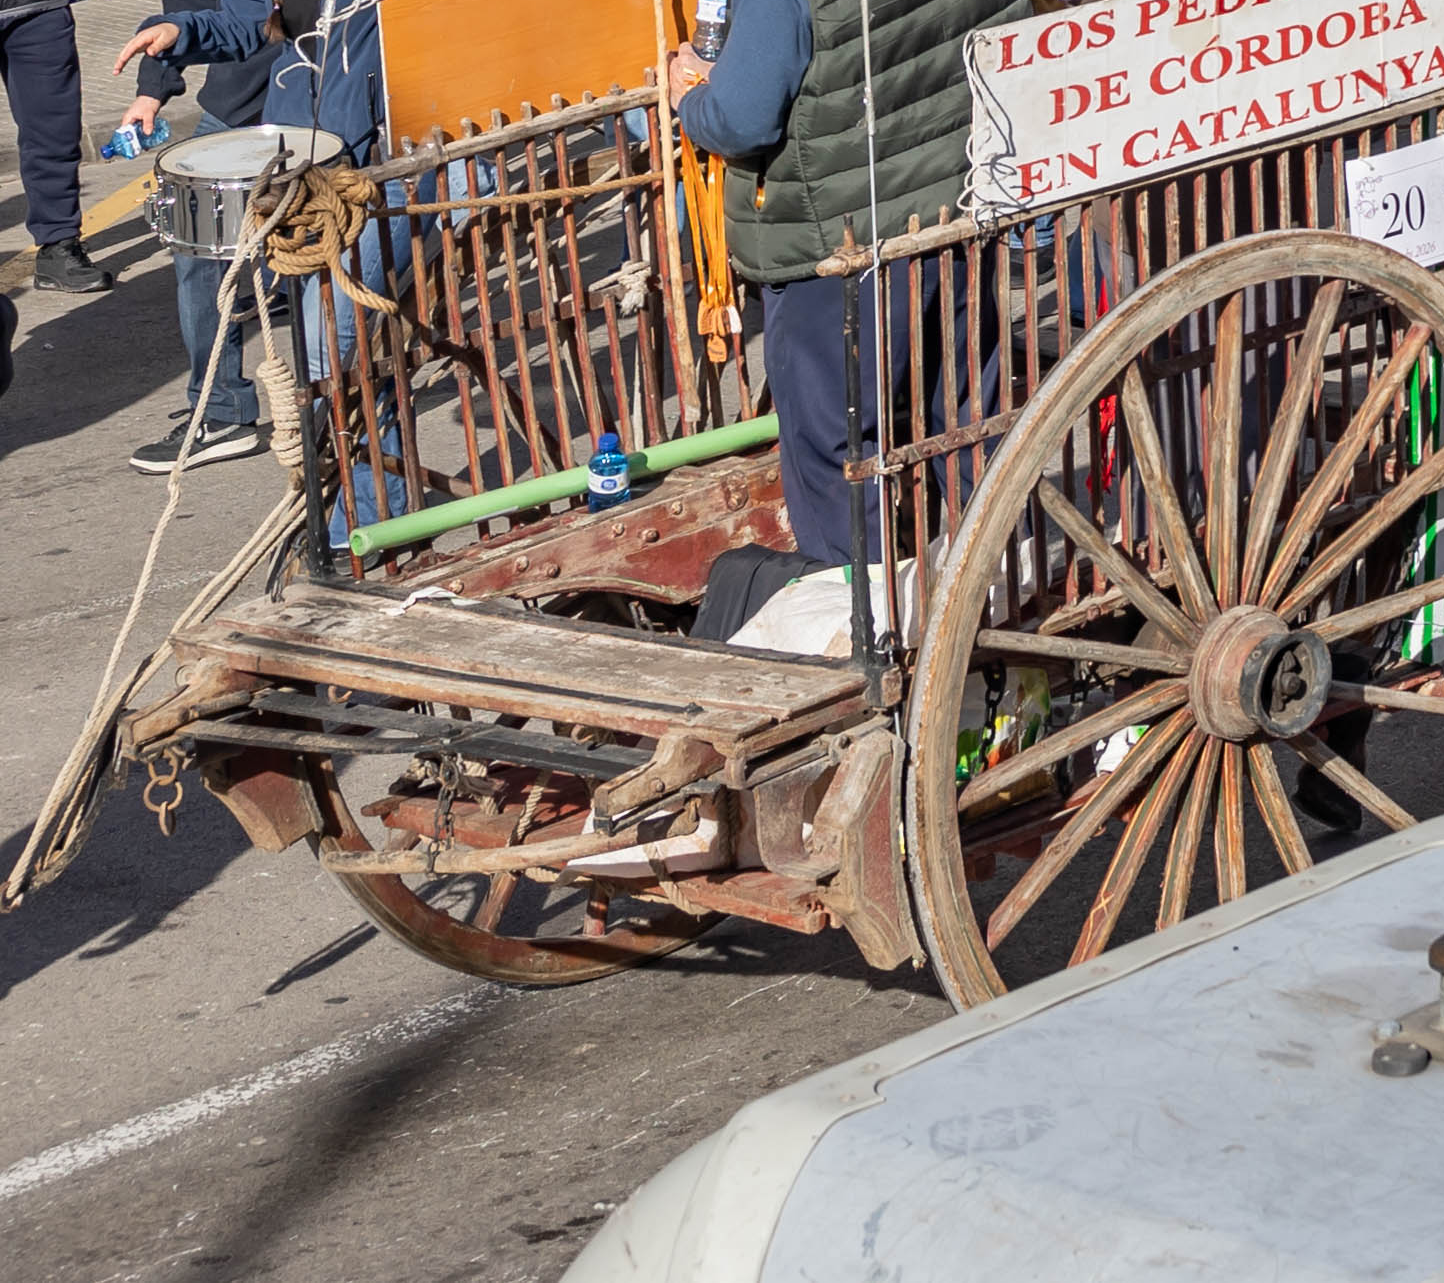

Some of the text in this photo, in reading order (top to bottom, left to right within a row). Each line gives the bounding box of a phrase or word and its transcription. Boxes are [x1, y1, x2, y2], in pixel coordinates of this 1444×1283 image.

[997, 8, 1116, 73] LOS
[1049, 70, 1130, 125] DE
[1017, 143, 1101, 200] EN
[1382, 185, 1426, 240] 20
